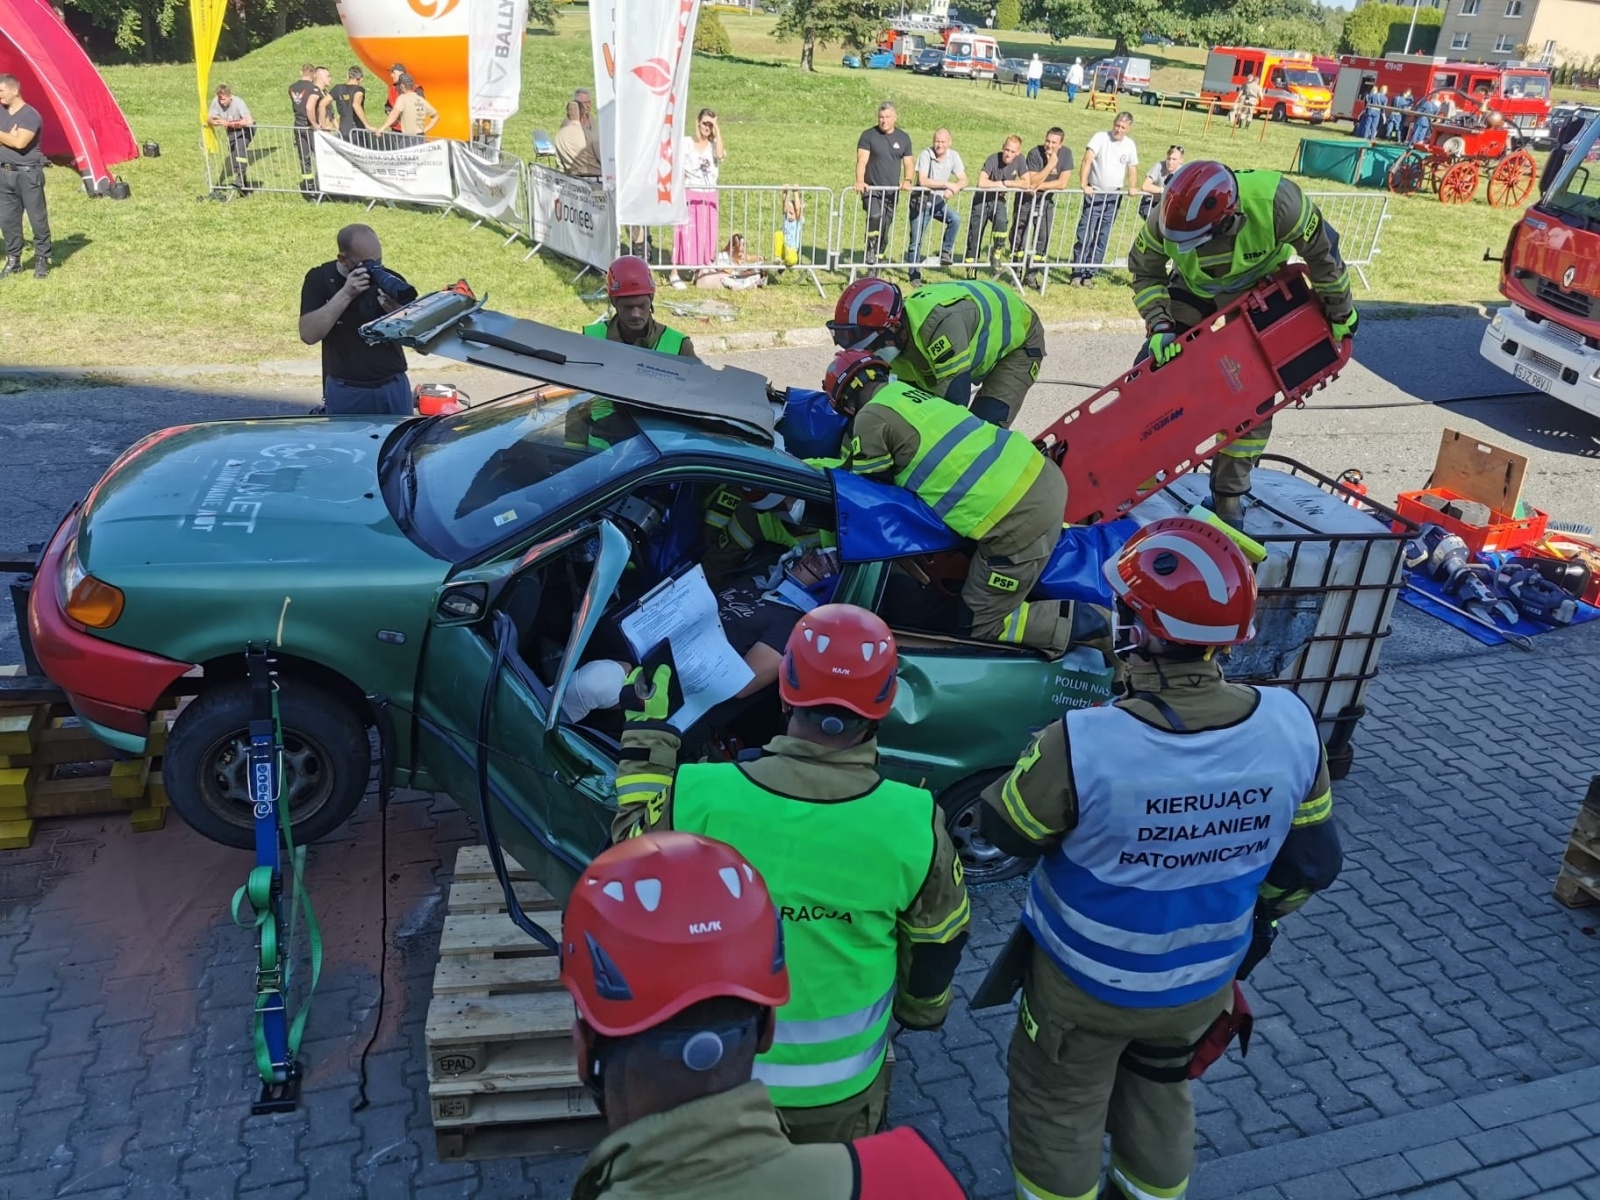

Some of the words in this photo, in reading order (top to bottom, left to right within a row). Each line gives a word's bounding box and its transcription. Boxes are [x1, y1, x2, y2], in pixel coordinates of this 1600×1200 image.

[1305, 217, 1318, 238] PSP
[930, 339, 946, 356] PSP
[721, 493, 740, 508] PSP
[992, 576, 1014, 589] PSP
[832, 666, 850, 676] KASK
[1055, 674, 1089, 691] POLUB
[1090, 683, 1111, 697] NAS
[1145, 786, 1274, 815] KIERUJĄCY
[1137, 814, 1271, 842] DZIAŁANIEM
[1118, 837, 1271, 870] RATOWNICZYM
[689, 920, 722, 935] KASK
[440, 1058, 468, 1071] EPAL
